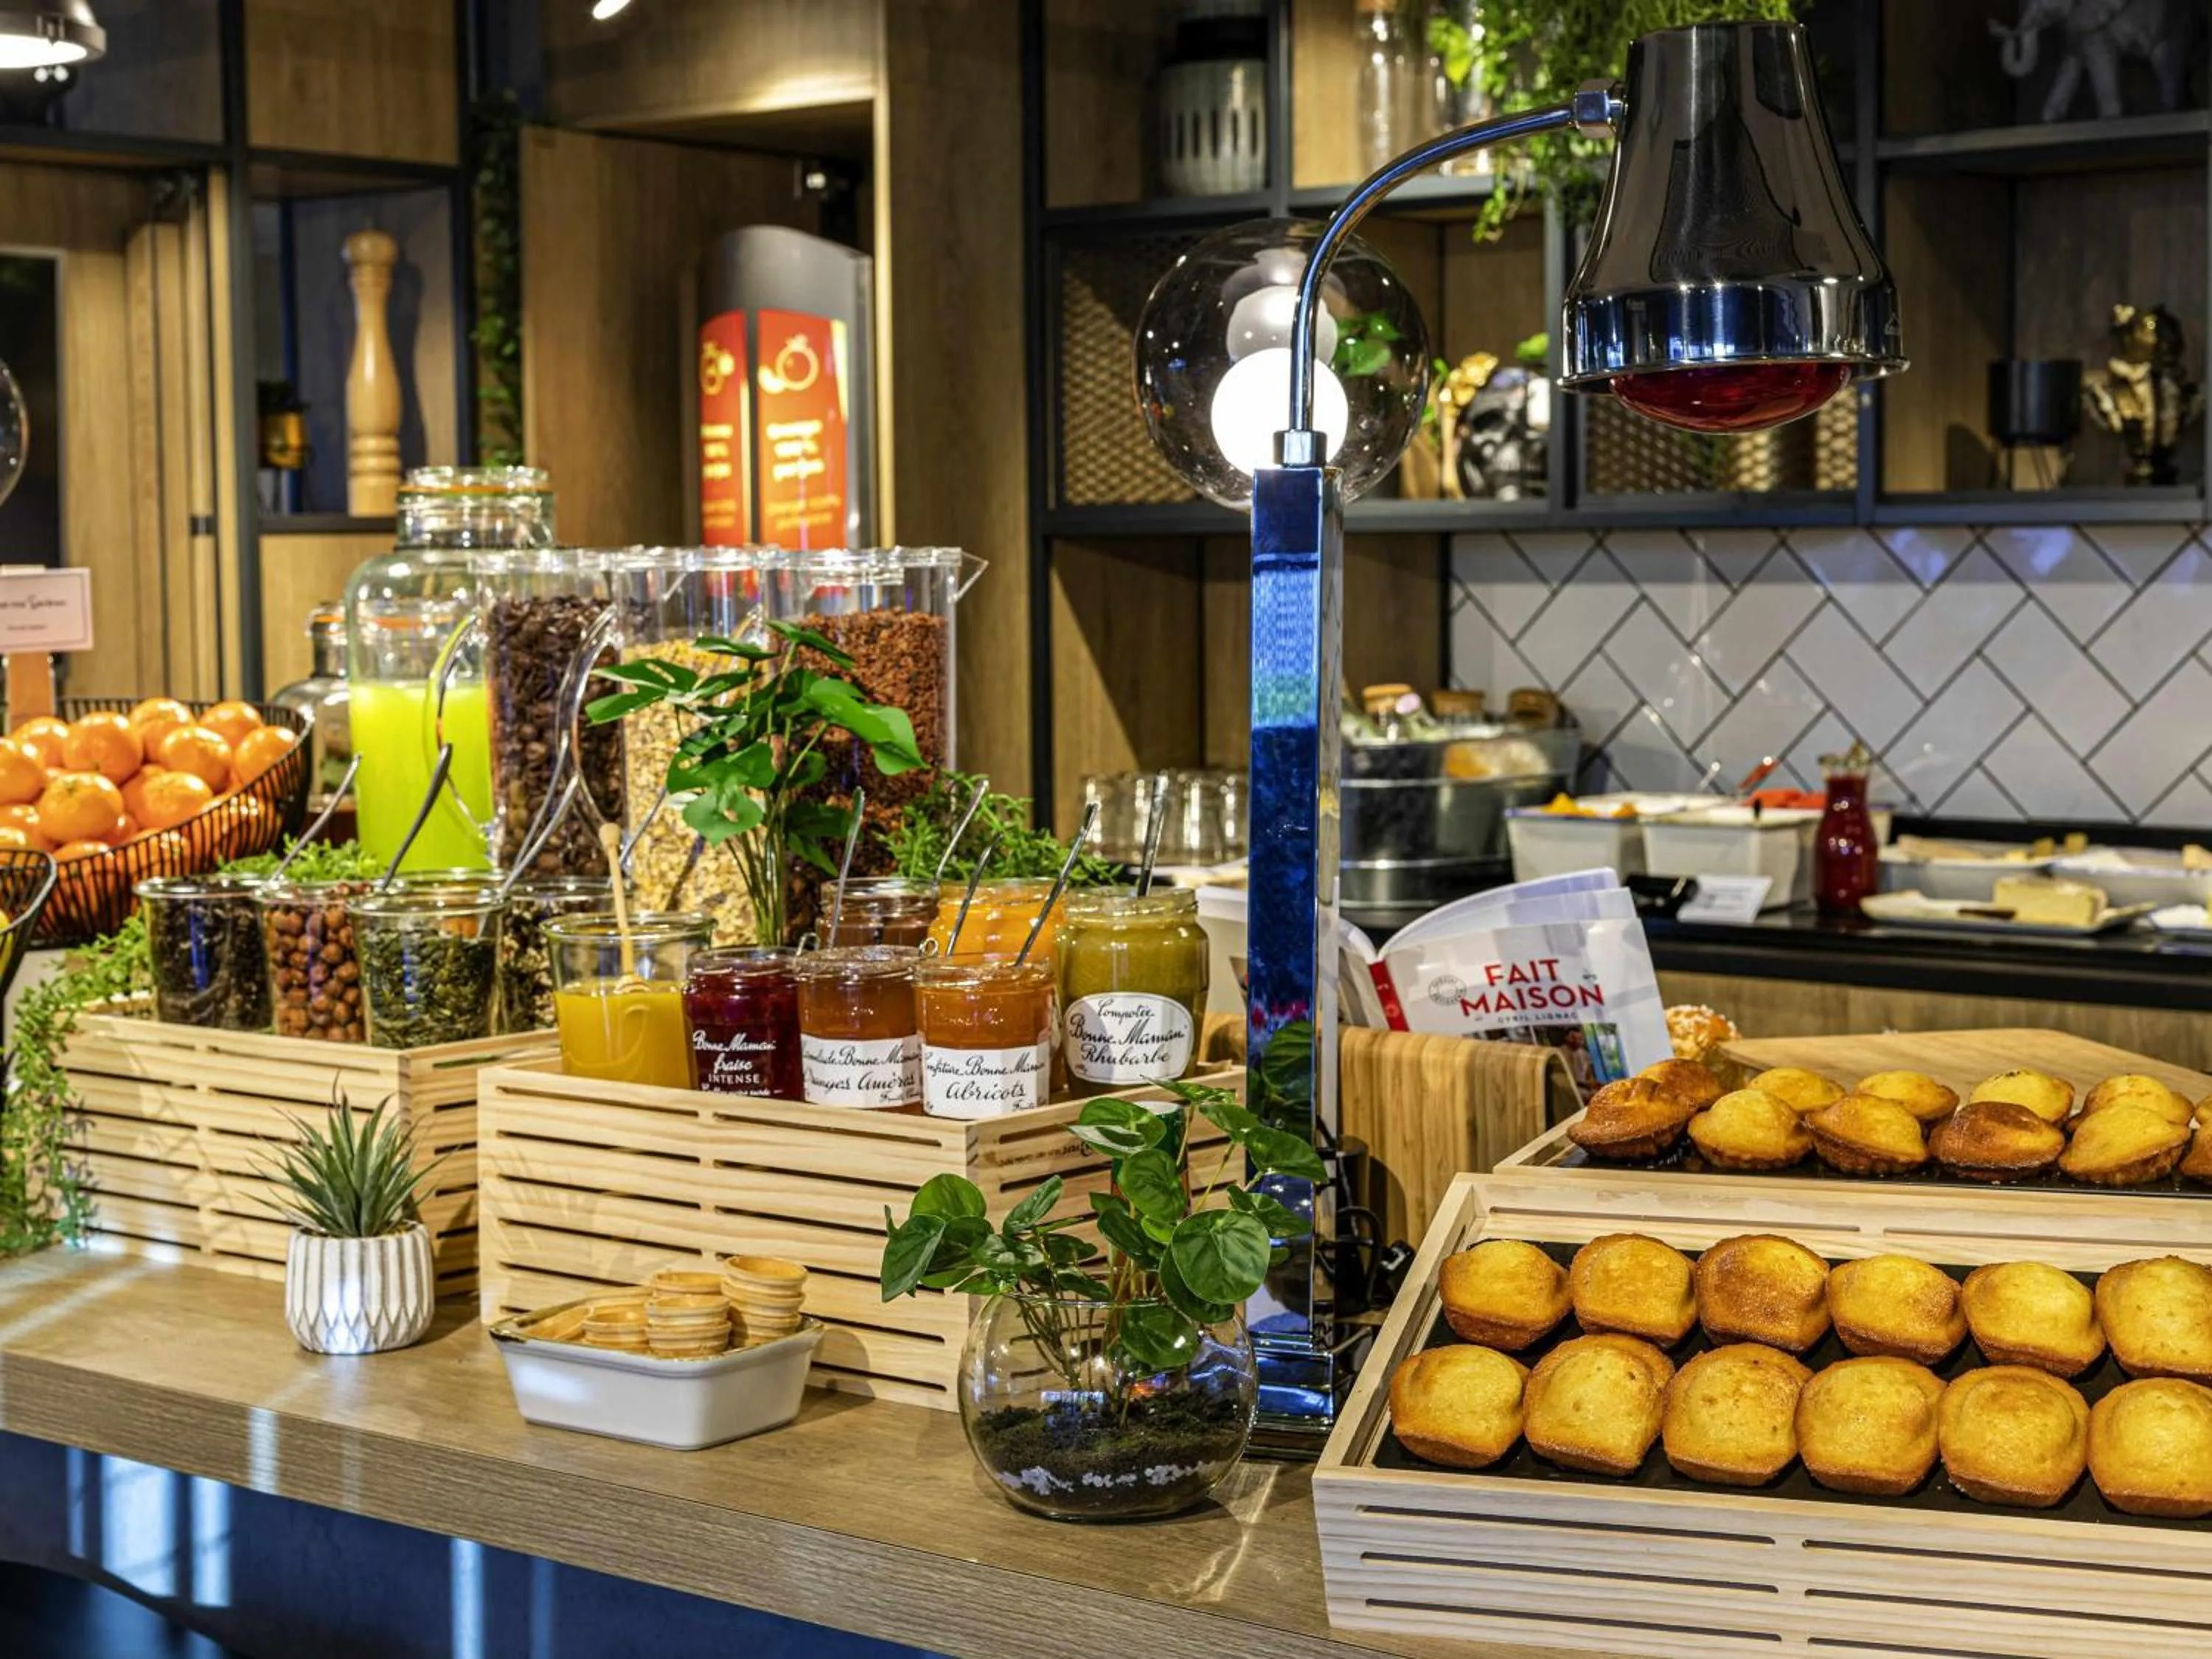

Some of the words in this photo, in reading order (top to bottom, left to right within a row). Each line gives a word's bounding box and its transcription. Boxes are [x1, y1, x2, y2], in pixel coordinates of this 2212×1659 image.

[1484, 958, 1560, 988] FAIT
[1459, 984, 1605, 1018] MAISON
[692, 1029, 730, 1051] Bonne
[728, 1032, 776, 1051] Maman
[1070, 1013, 1117, 1045] Bonne
[1118, 1018, 1188, 1046] Maman
[839, 1045, 882, 1066] Bonne
[1080, 1043, 1169, 1065] Rhubarbe
[965, 1054, 1008, 1077] Bonne
[709, 1074, 759, 1085] INTENSE
[946, 1080, 1026, 1101] Abricots
